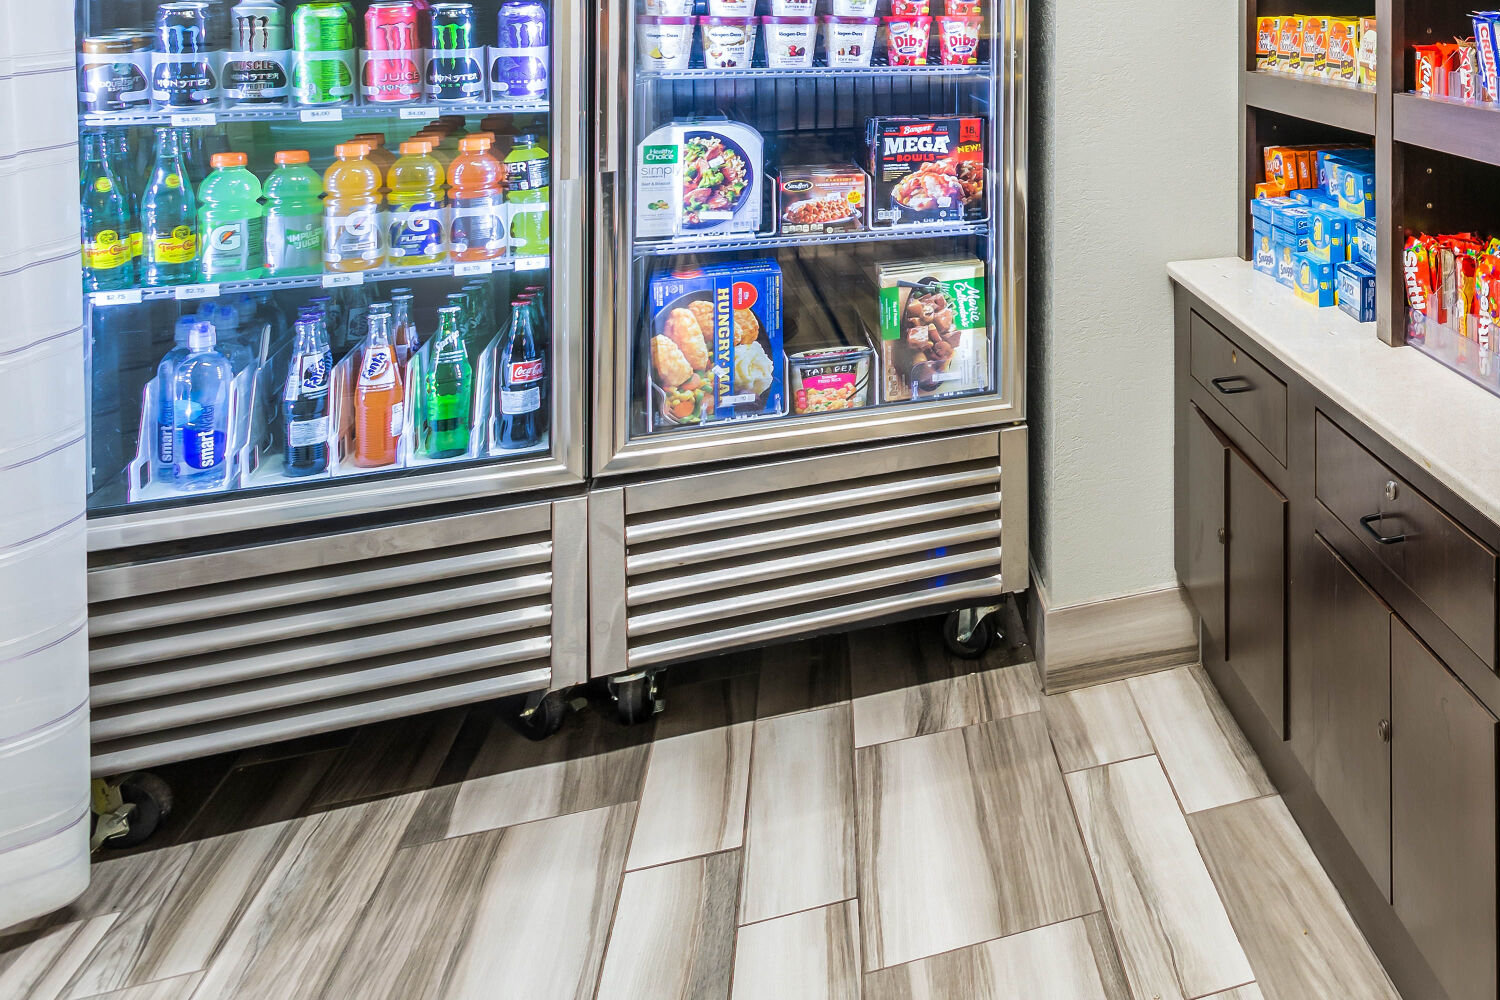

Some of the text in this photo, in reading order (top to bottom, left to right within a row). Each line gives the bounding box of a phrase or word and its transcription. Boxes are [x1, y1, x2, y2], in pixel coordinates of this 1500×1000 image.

[894, 34, 924, 48] Dibs
[950, 34, 976, 47] Dibs
[380, 72, 419, 82] JUICE
[884, 136, 950, 155] MEGA
[957, 143, 982, 154] NEW!
[650, 148, 673, 156] Healthy
[896, 153, 935, 162] BOWLS
[641, 166, 681, 178] simply
[362, 351, 387, 380] Fanta
[805, 365, 852, 377] TAI PEI
